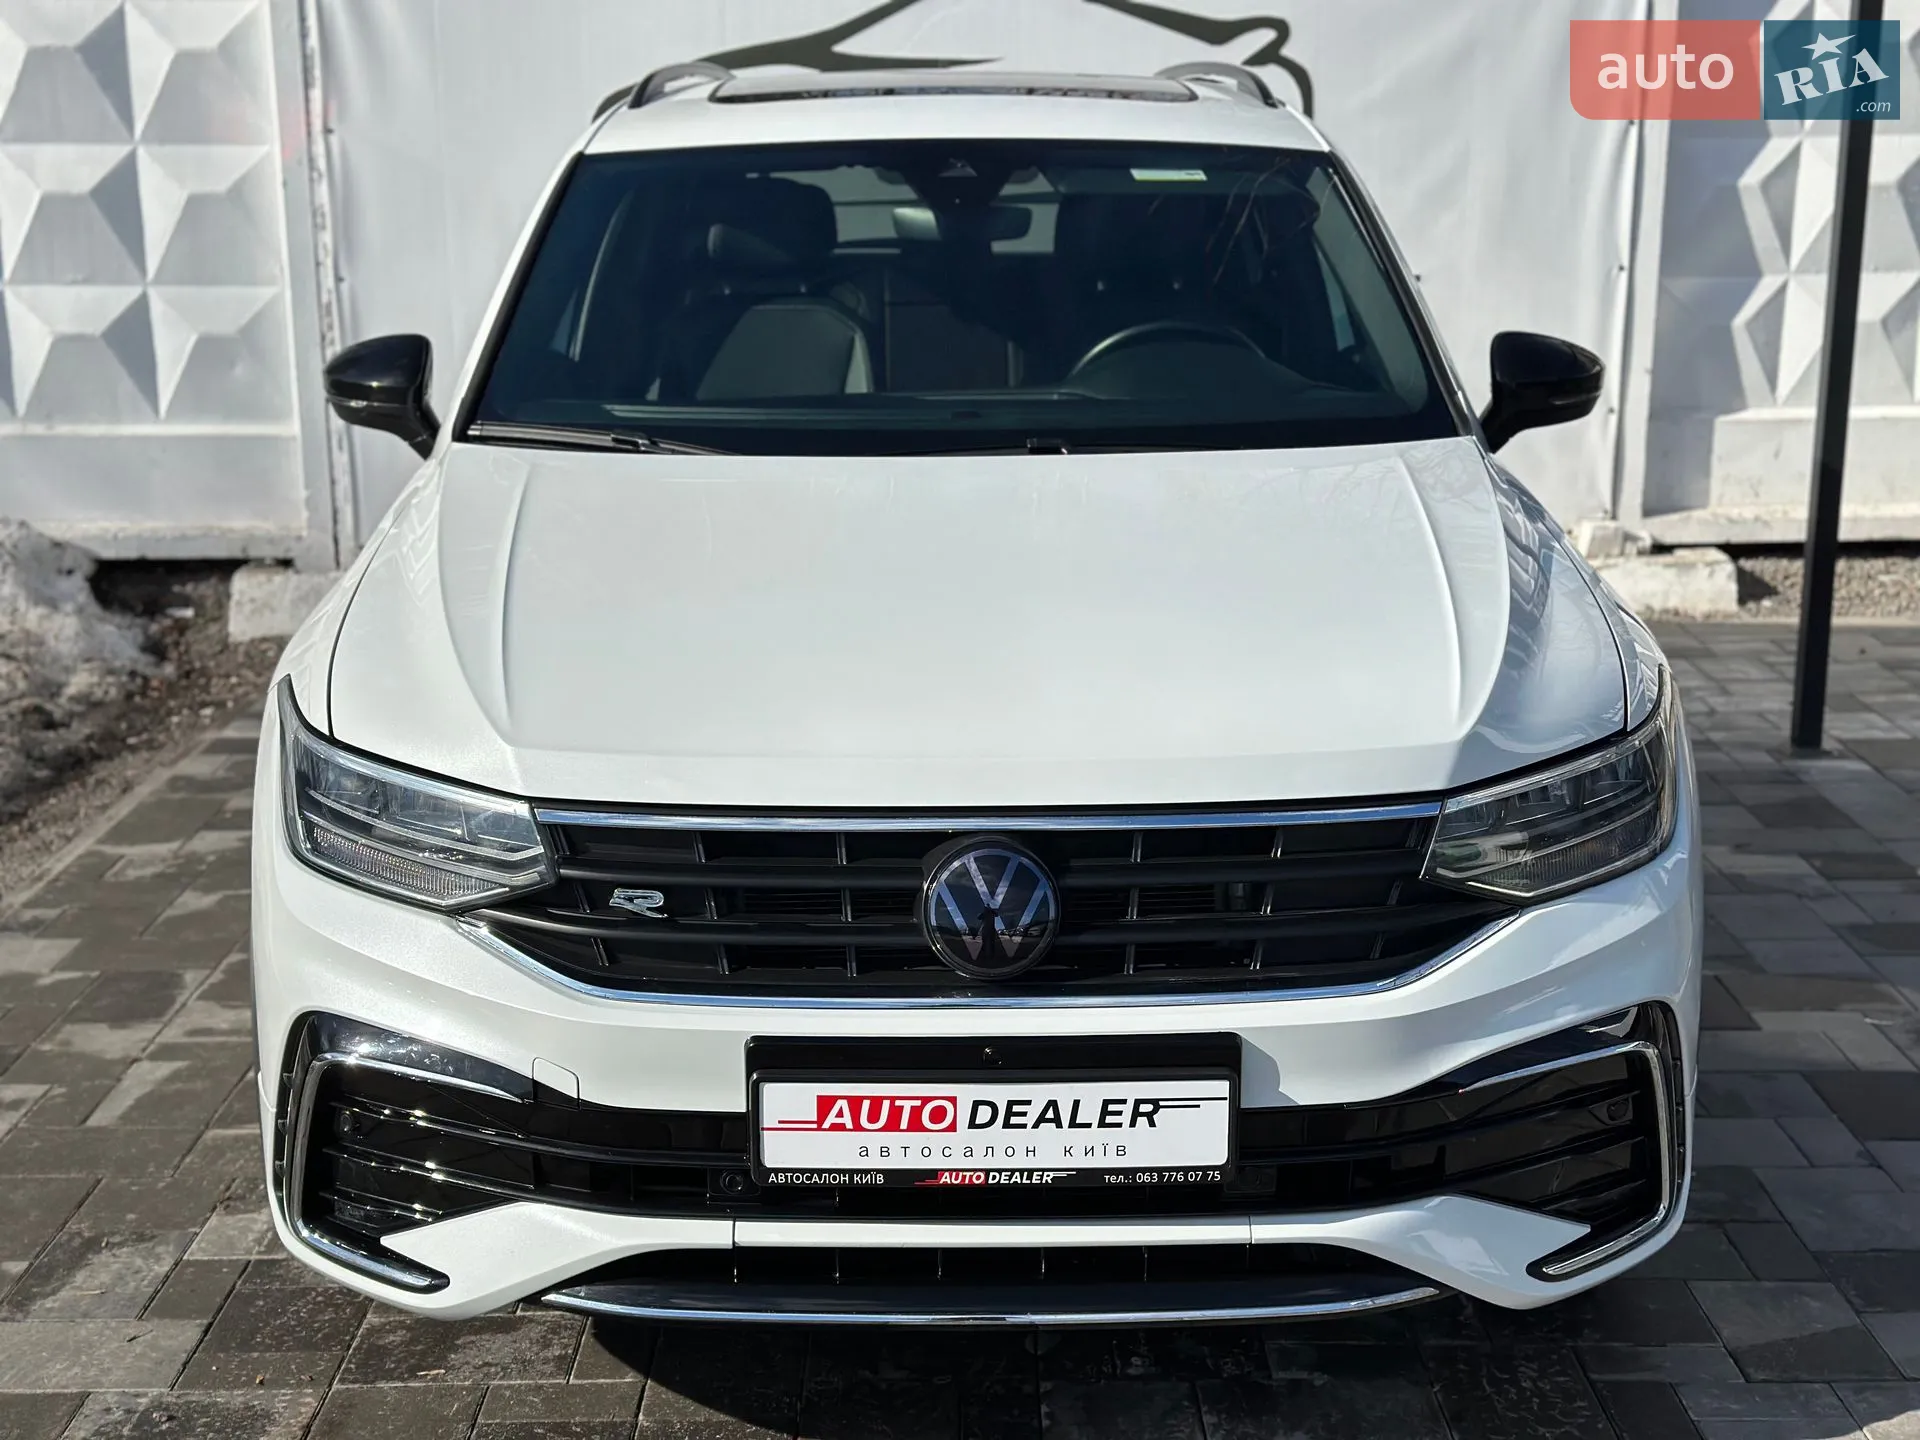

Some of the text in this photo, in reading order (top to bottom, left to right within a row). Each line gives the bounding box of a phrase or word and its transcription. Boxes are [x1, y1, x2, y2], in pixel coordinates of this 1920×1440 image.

[821, 1098, 1161, 1131] AUTO DEALER
[858, 1143, 1128, 1158] автосалон київ
[768, 1171, 885, 1185] АВТОСАЛОН КИЇВ
[939, 1171, 1053, 1184] AUTO DEALER
[1103, 1170, 1221, 1184] тел.: 063 776 07 75
